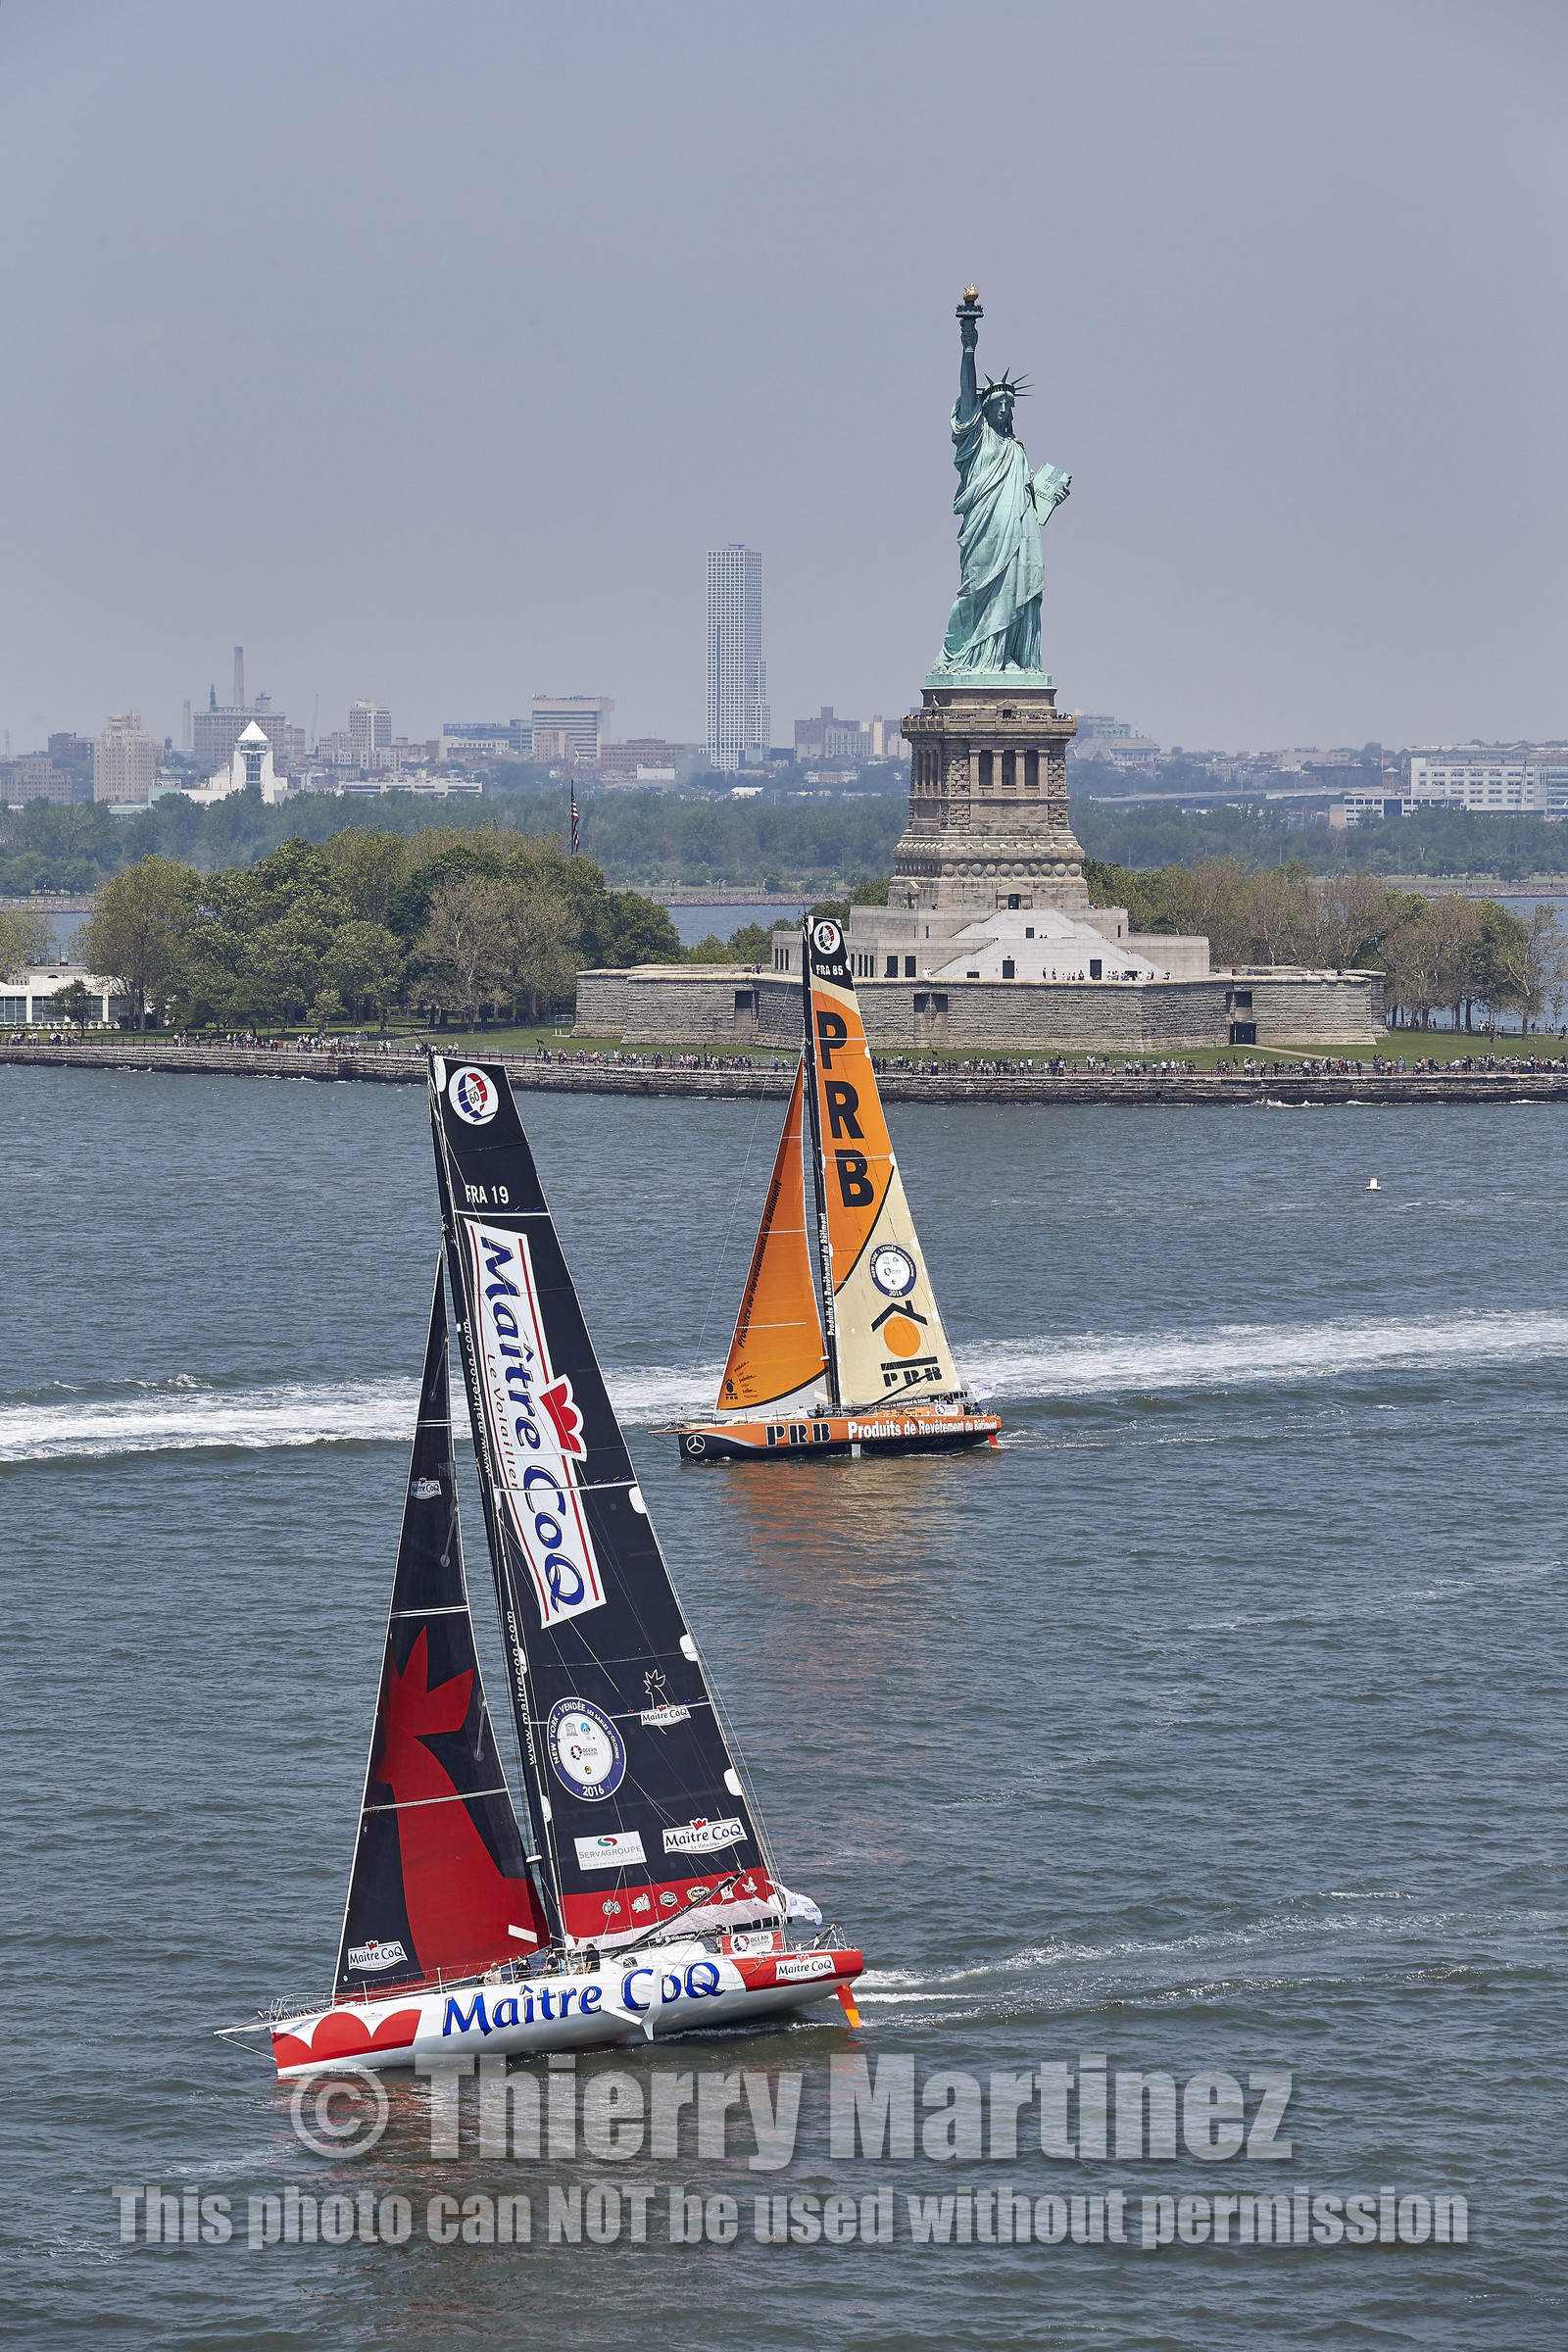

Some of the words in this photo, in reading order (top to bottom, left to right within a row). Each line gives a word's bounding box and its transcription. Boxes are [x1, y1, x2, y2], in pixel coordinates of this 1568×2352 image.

[815, 964, 831, 976] FRA
[832, 964, 844, 976] 85
[468, 1090, 480, 1104] 60
[816, 1010, 875, 1208] PRB
[465, 1184, 488, 1204] FRA
[490, 1185, 510, 1205] 19
[486, 1353, 498, 1380] Le
[883, 1366, 943, 1388] PRB
[480, 1236, 541, 1450] Maître
[522, 1464, 586, 1614] CoQ
[764, 1421, 832, 1447] PRB
[847, 1419, 902, 1441] Produits
[904, 1419, 917, 1437] de
[917, 1419, 965, 1435] Revêtement
[964, 1419, 974, 1432] du
[973, 1418, 998, 1432] Bâtiment
[559, 1700, 586, 1714] VENDÉE
[549, 1714, 560, 1740] YORK
[549, 1741, 561, 1765] NEW
[582, 1784, 605, 1797] 2016
[665, 1831, 710, 1847] Maître
[711, 1823, 744, 1840] CoQ
[578, 1844, 642, 1859] SERVAGROUPE
[750, 1935, 769, 1943] OCEAN
[380, 1945, 405, 1960] CoQ
[810, 1959, 833, 1972] CoQ
[442, 1984, 603, 2037] Maître
[621, 1961, 726, 2011] CoQ
